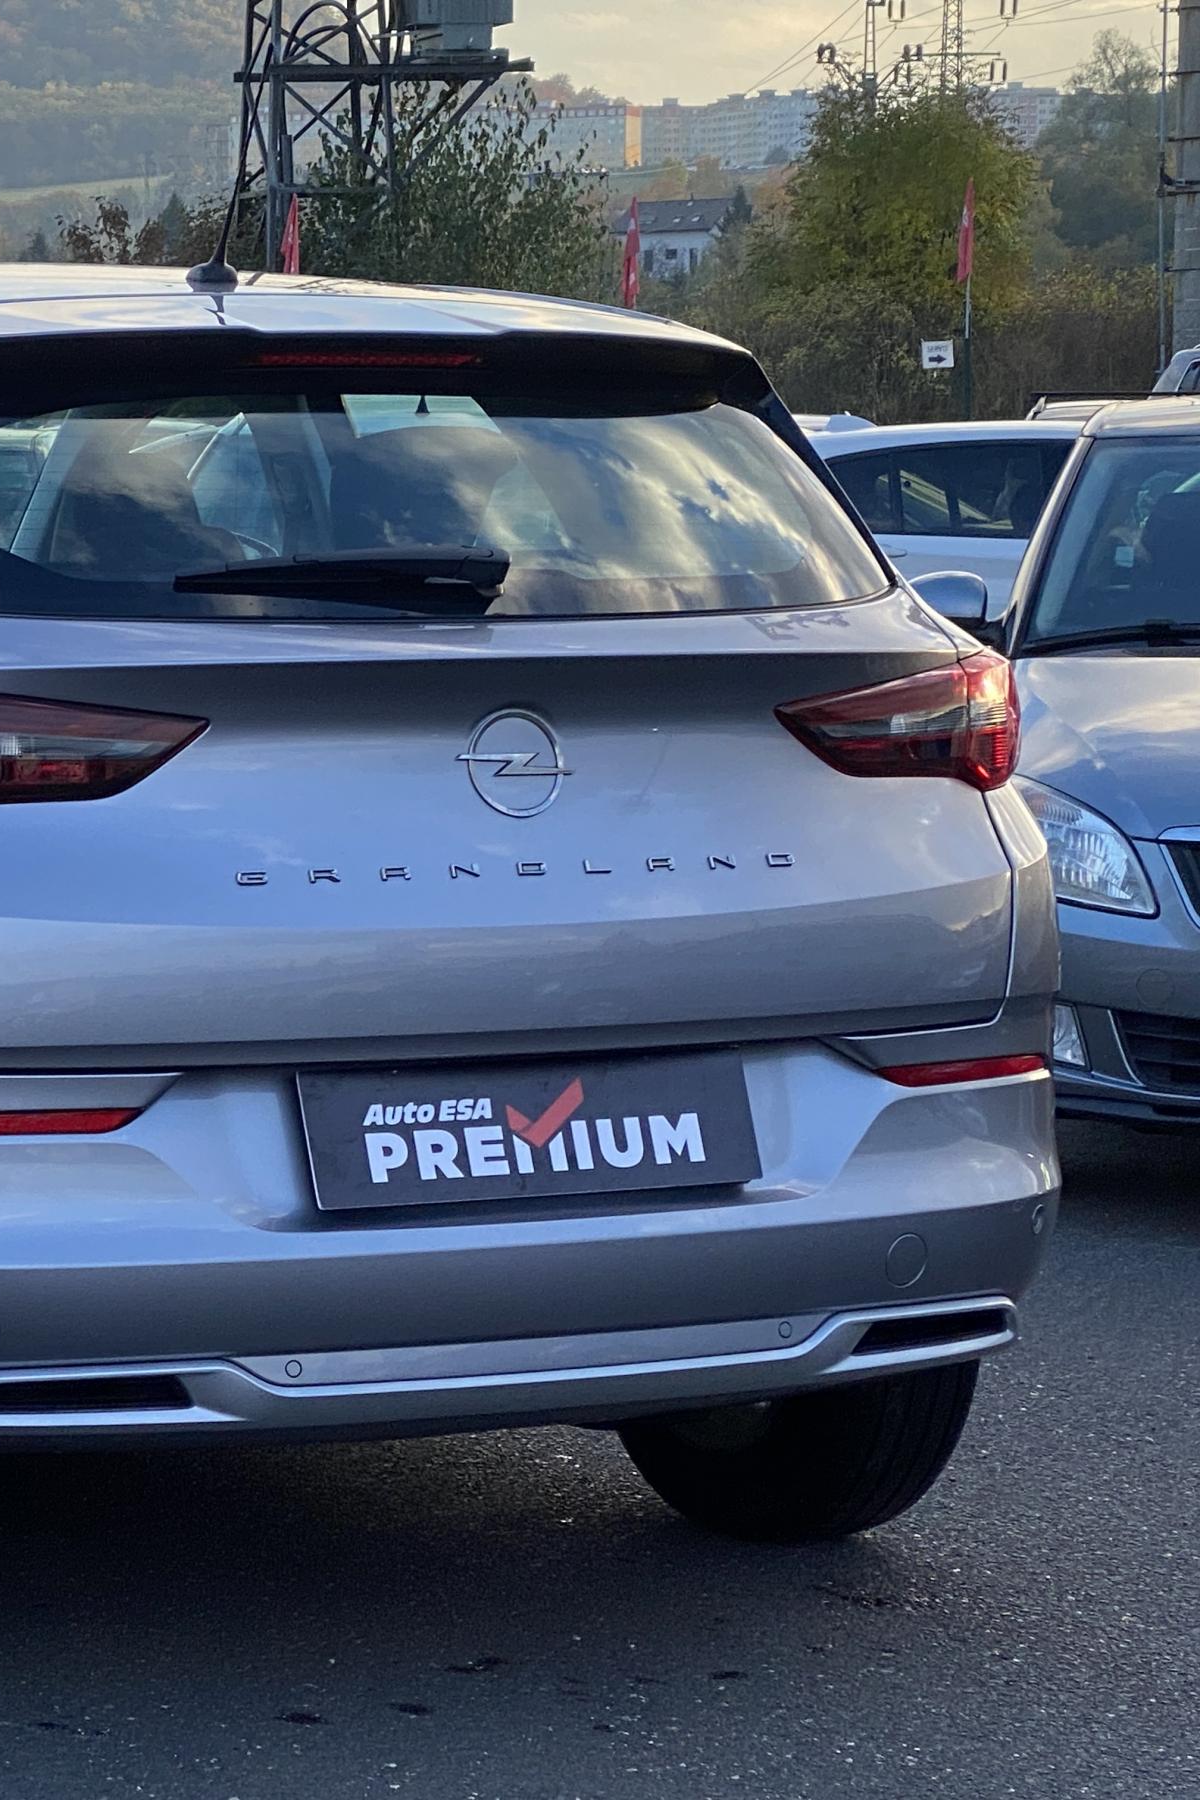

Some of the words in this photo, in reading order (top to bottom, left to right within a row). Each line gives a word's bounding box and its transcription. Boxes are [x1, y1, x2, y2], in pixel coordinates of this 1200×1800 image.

[235, 851, 796, 887] GRANDLAND
[362, 1102, 435, 1127] Auto
[439, 1097, 492, 1121] ESA
[364, 1111, 706, 1184] PREMIUM
